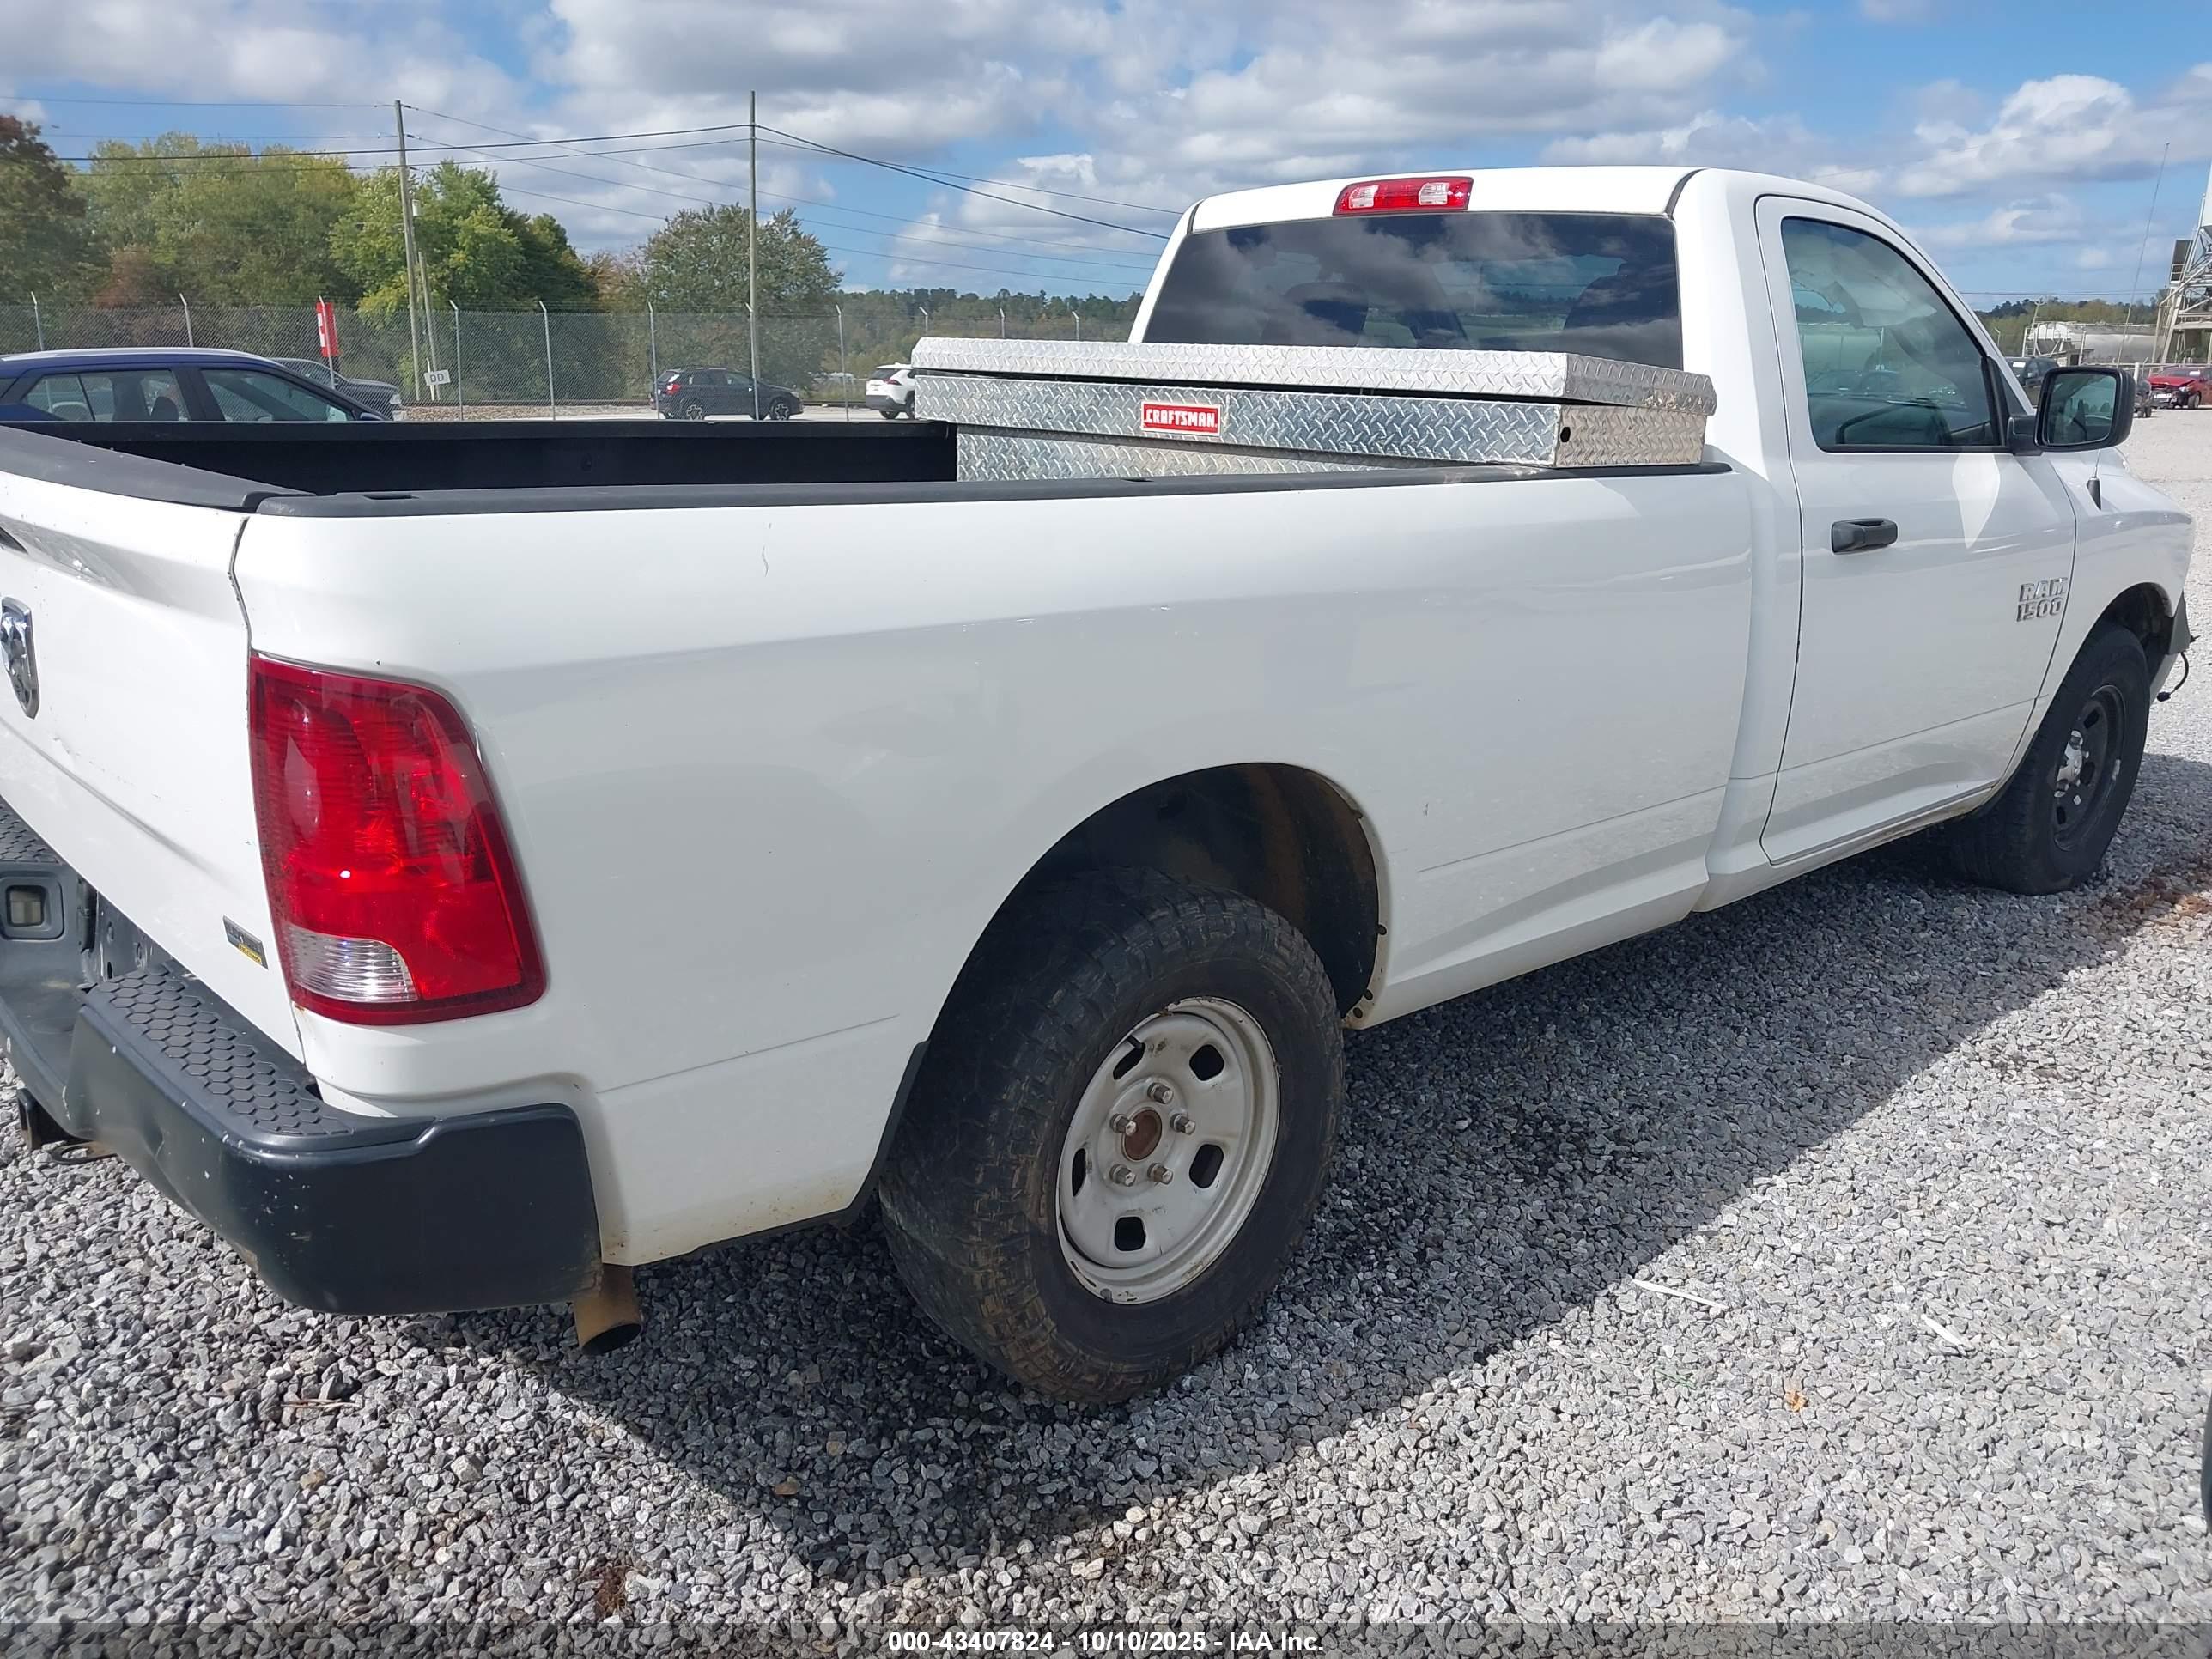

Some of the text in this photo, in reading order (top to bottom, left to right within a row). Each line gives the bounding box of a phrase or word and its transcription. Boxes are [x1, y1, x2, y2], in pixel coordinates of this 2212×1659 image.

[1145, 409, 1216, 428] CRAFTSMAN
[2019, 577, 2068, 602] RAM
[2016, 597, 2063, 622] 1500
